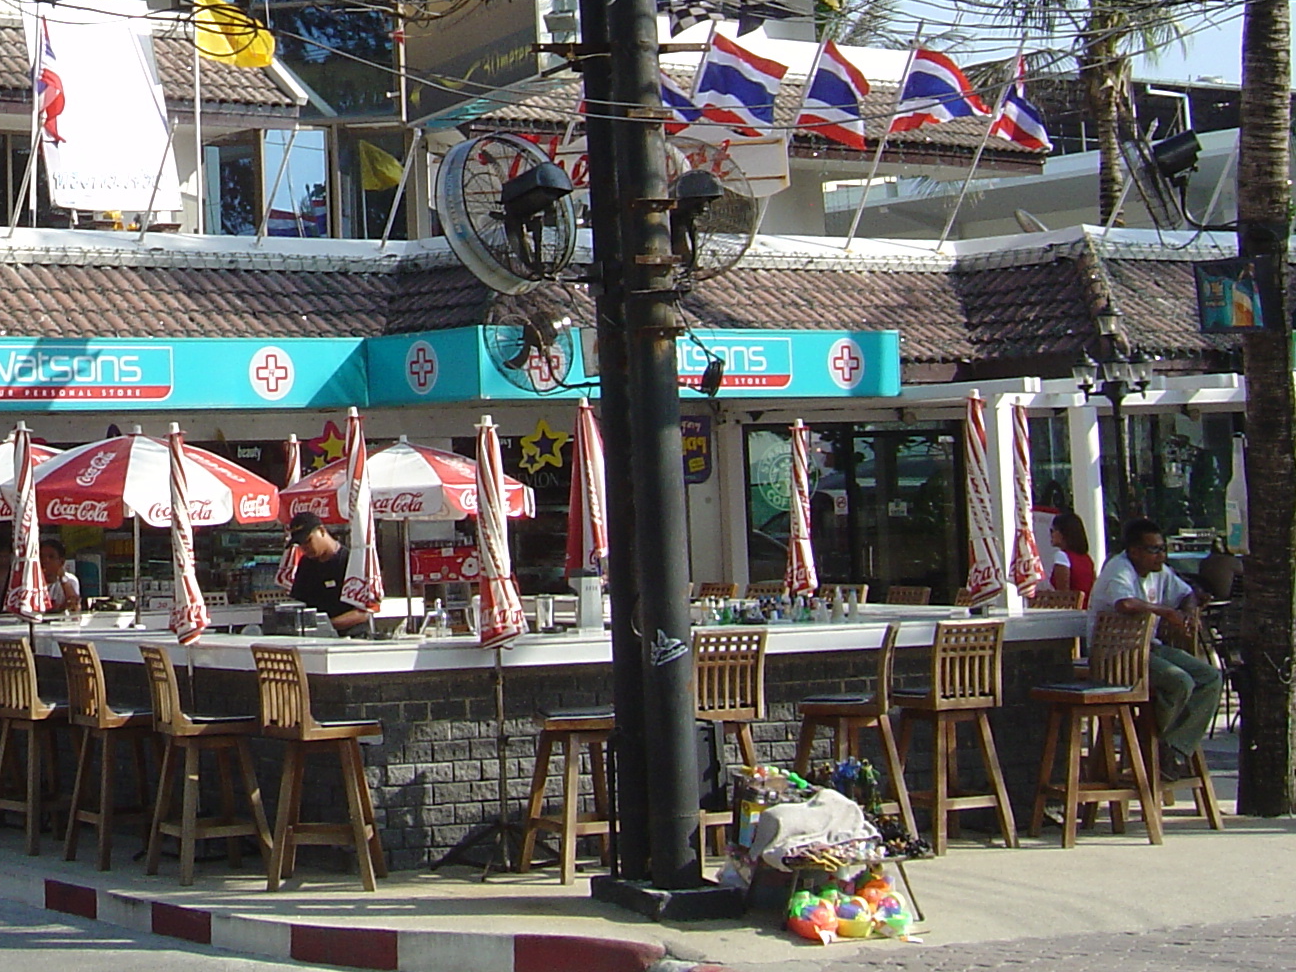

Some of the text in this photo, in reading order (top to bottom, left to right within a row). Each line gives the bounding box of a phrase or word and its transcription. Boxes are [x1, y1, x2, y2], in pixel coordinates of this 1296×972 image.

[676, 341, 768, 372] tsons
[734, 377, 767, 385] STORE
[24, 389, 92, 397] PERSONAL
[101, 389, 142, 397] STORE
[46, 498, 109, 522] Coca-Cola
